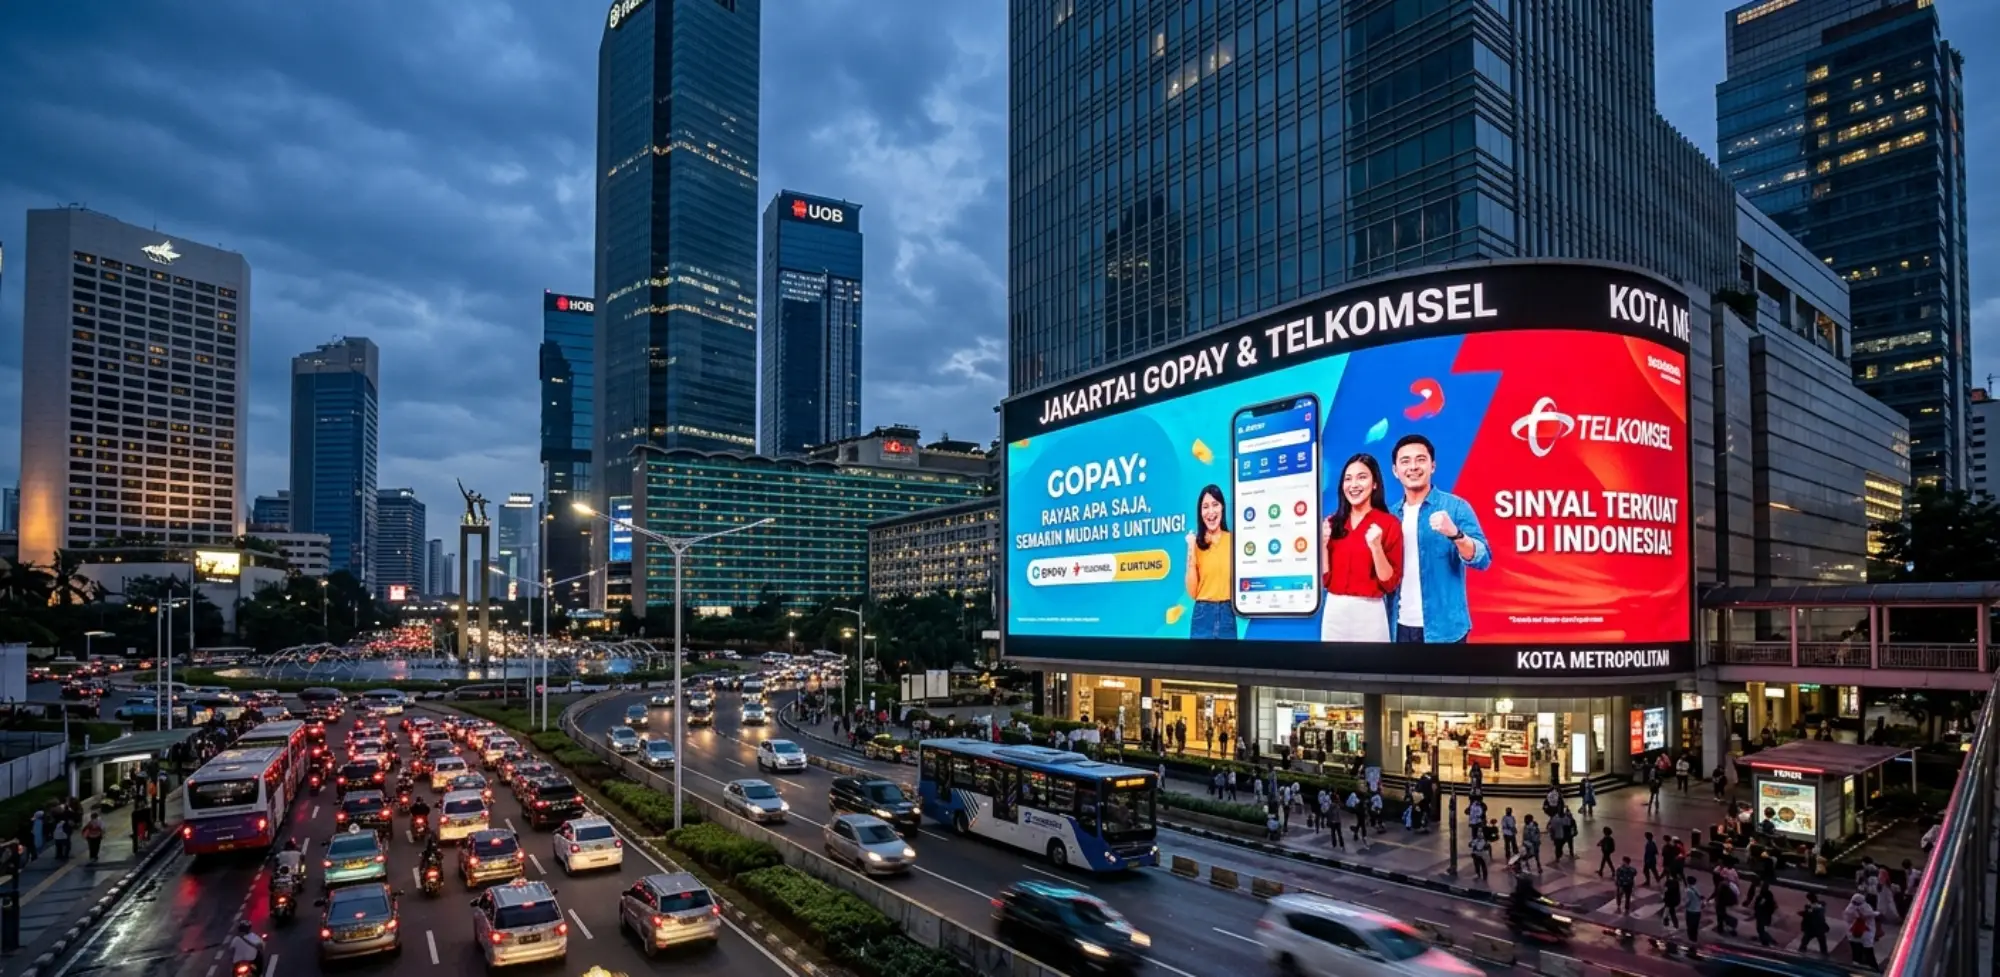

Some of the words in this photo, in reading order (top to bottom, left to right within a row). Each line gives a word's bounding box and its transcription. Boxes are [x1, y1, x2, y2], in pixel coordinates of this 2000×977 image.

[808, 204, 843, 222] UOB
[1039, 372, 1137, 425] JAKARTA!
[1143, 342, 1230, 394] GOPAY
[1236, 335, 1258, 367] &
[1265, 282, 1498, 359] TELKOMSEL
[1609, 283, 1670, 334] KOTA
[1577, 414, 1673, 451] TELKOMSEL
[1047, 453, 1147, 498] GOPAY:
[1083, 501, 1109, 519] APA
[1494, 489, 1597, 518] SINYAL
[1602, 491, 1679, 524] TERKUAT
[1065, 524, 1109, 543] MUDAH
[1124, 514, 1186, 538] UNTUNG!
[1516, 525, 1545, 552] DI
[1554, 525, 1673, 555] INDONESIA!
[1517, 651, 1566, 670] KOTA
[1570, 649, 1670, 669] METROPOLITAN
